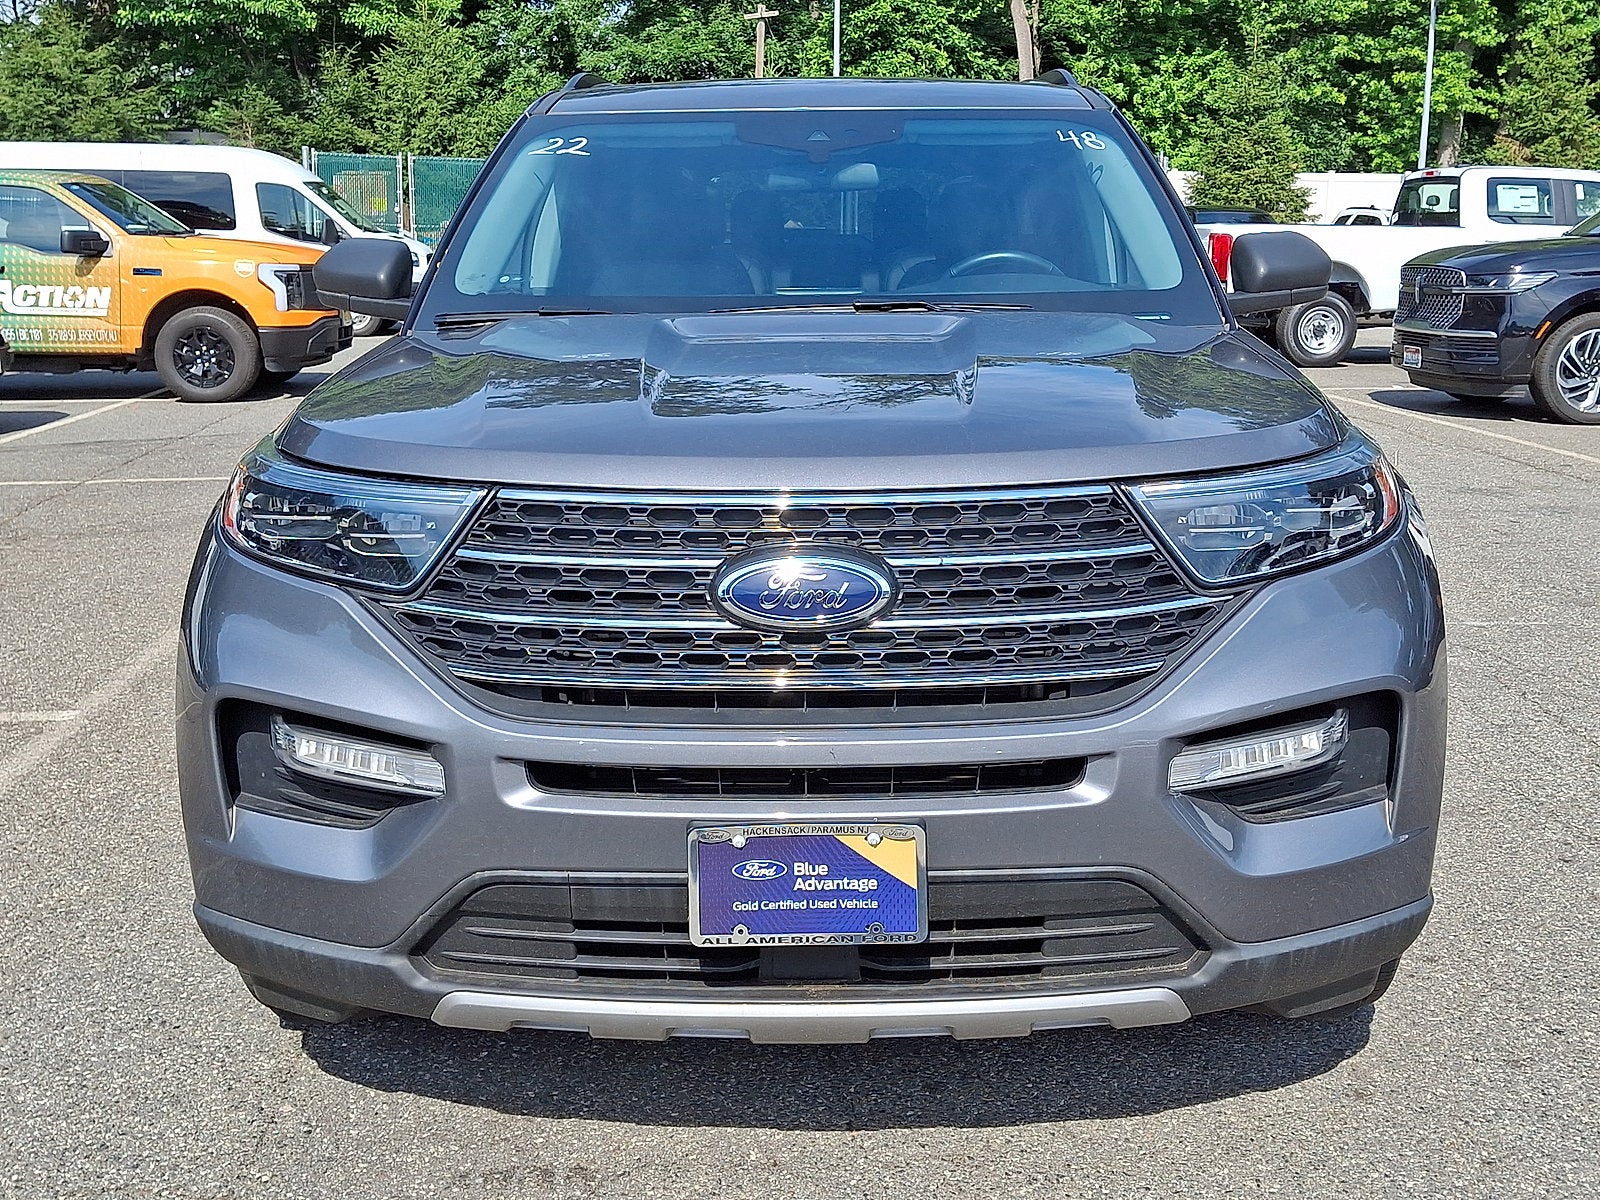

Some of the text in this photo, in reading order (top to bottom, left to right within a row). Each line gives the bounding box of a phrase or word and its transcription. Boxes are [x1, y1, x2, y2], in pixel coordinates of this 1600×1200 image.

[527, 137, 591, 156] 22
[1056, 130, 1106, 150] 48
[759, 567, 850, 610] Ford
[857, 826, 870, 834] NJ
[742, 862, 777, 877] Ford
[793, 862, 829, 876] Blue
[793, 877, 878, 892] Advantage
[732, 898, 878, 911] Gold Certified Used Vehicle
[701, 934, 918, 945] ALL AMERICAN FORD
